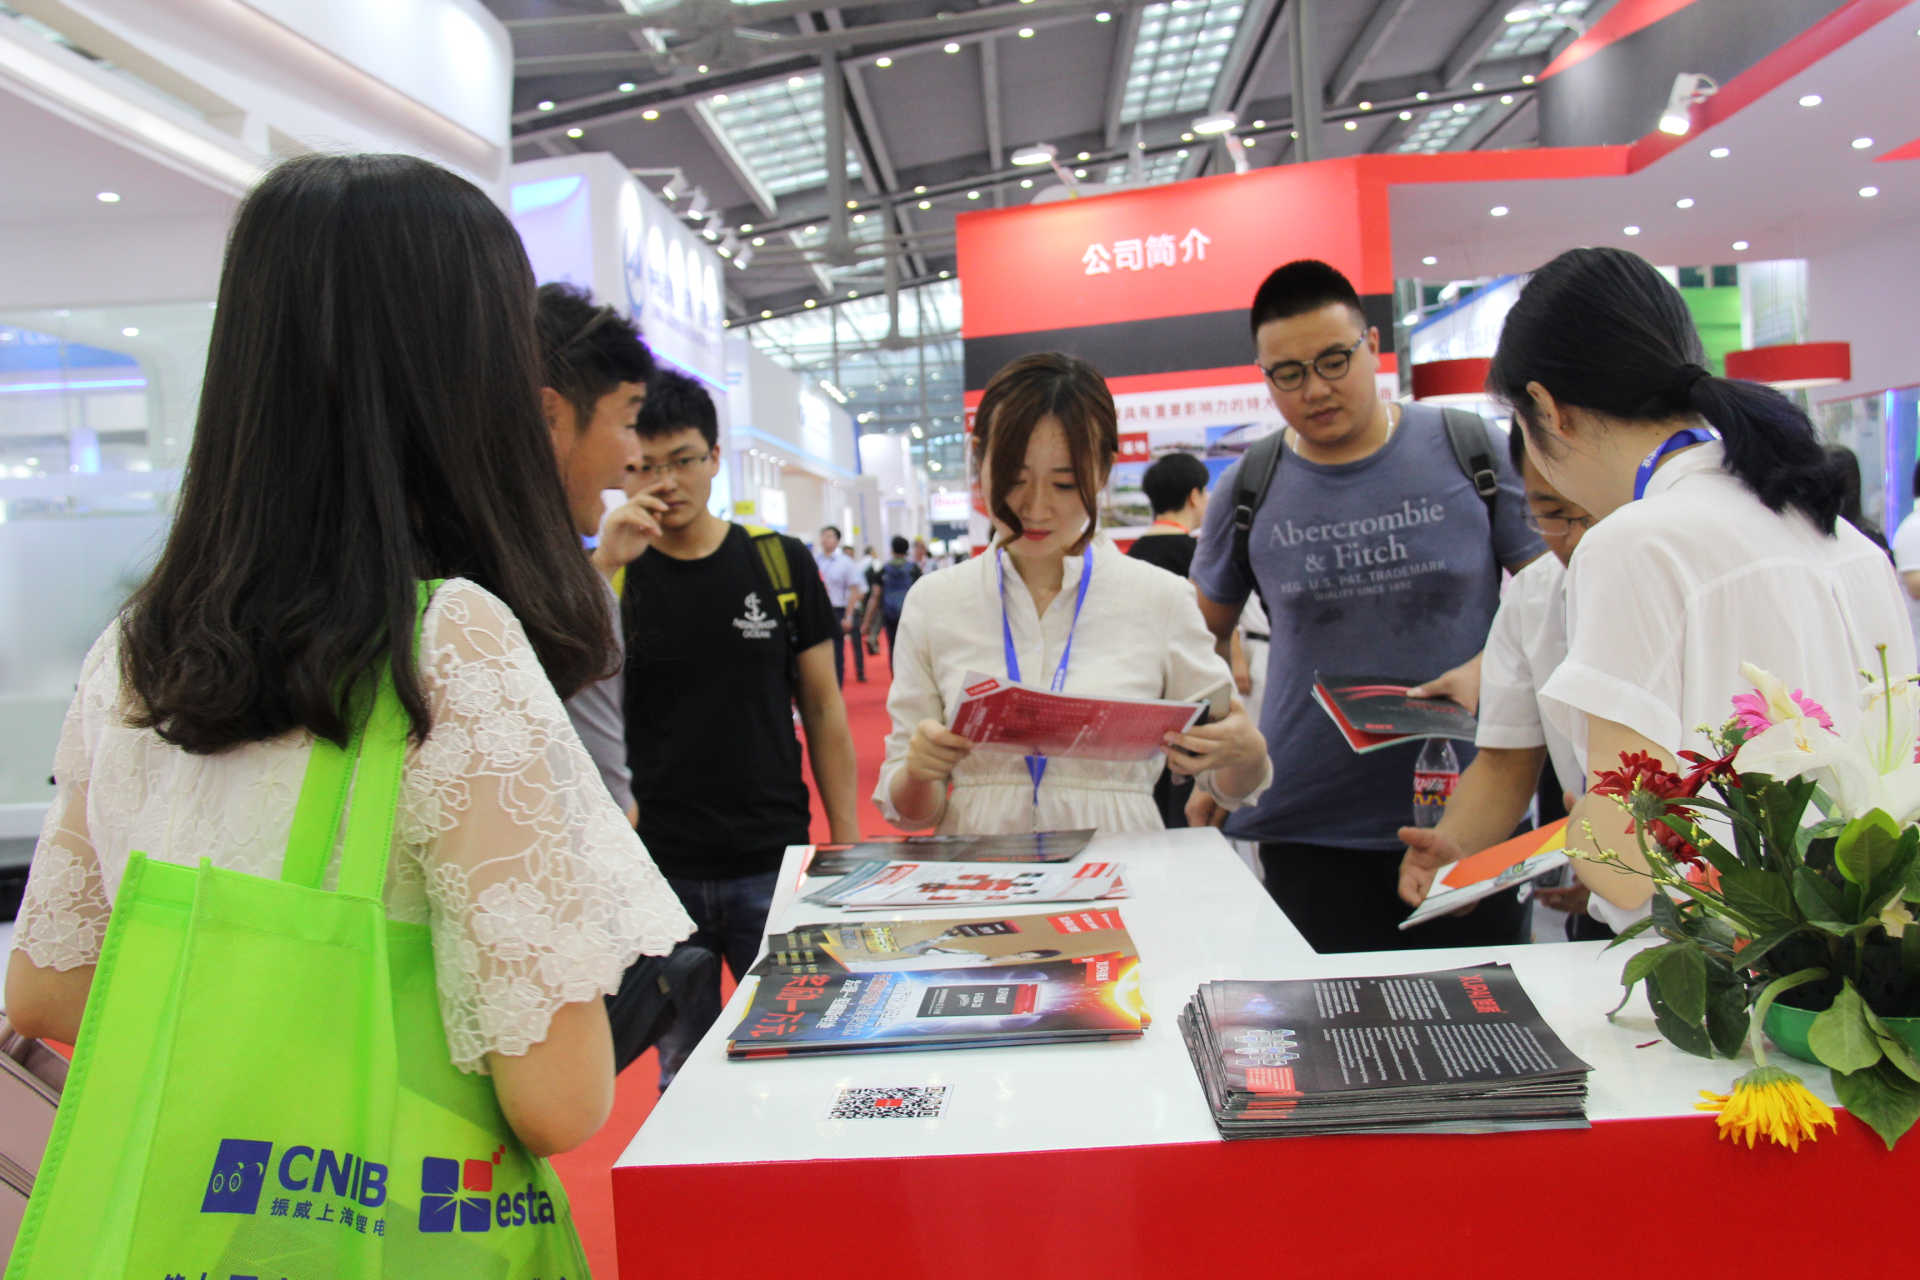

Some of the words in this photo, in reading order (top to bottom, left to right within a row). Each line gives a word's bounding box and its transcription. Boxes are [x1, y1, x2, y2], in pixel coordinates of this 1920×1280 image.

[1082, 228, 1212, 276] 公司简介
[1270, 498, 1446, 549] Abercrombie
[1304, 553, 1327, 573] &
[1334, 535, 1409, 569] Fitch
[1369, 560, 1447, 582] TRADEMARK
[750, 974, 831, 1037] 奖励一万元
[278, 1145, 389, 1208] CNIB
[495, 1182, 556, 1228] esta
